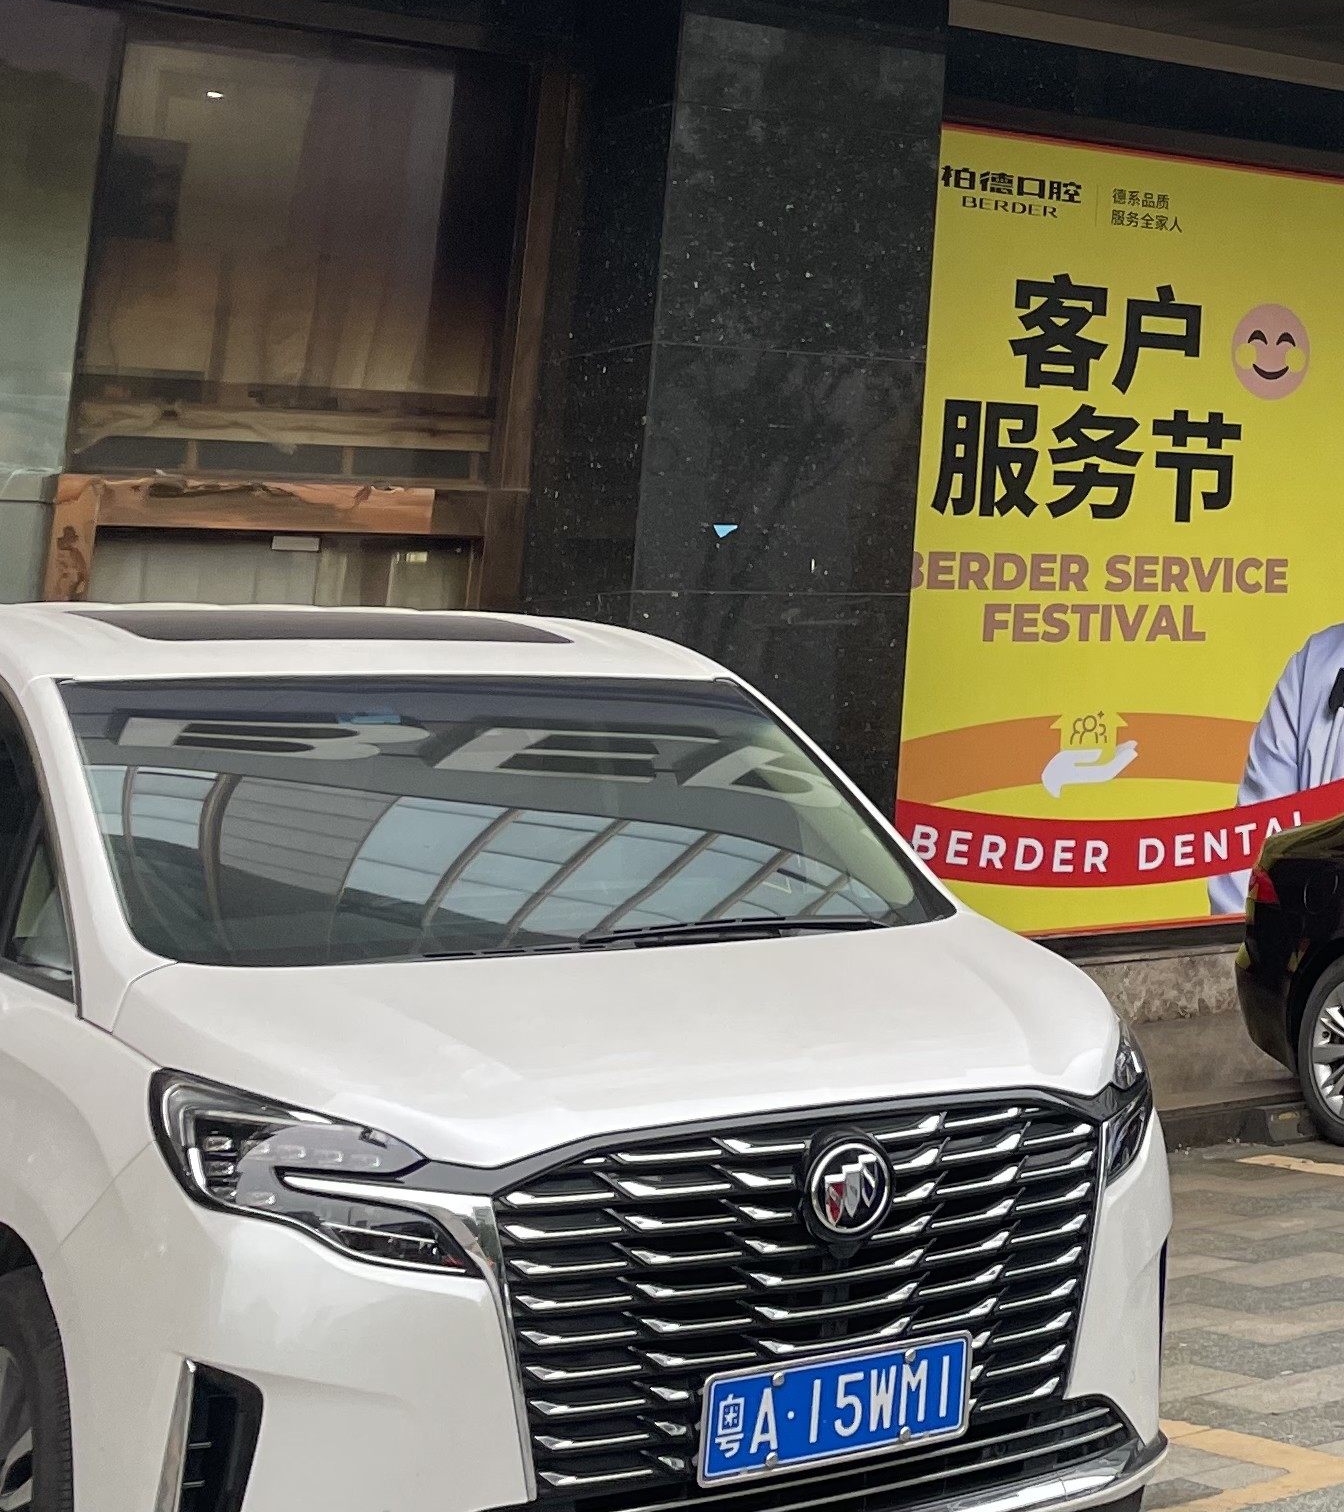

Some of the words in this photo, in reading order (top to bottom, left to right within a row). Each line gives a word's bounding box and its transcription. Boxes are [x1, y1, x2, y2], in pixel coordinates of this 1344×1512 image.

[941, 165, 1082, 204] 柏德口腔
[1112, 188, 1170, 210] 德系品质
[962, 195, 1058, 219] BERDER
[1111, 209, 1183, 233] 服务全家人
[1009, 273, 1202, 392] 客户
[930, 399, 1243, 524] 服务节
[1104, 554, 1289, 594] SERVICE
[982, 604, 1207, 643] FESTIVAL
[911, 825, 1110, 873] BERDER
